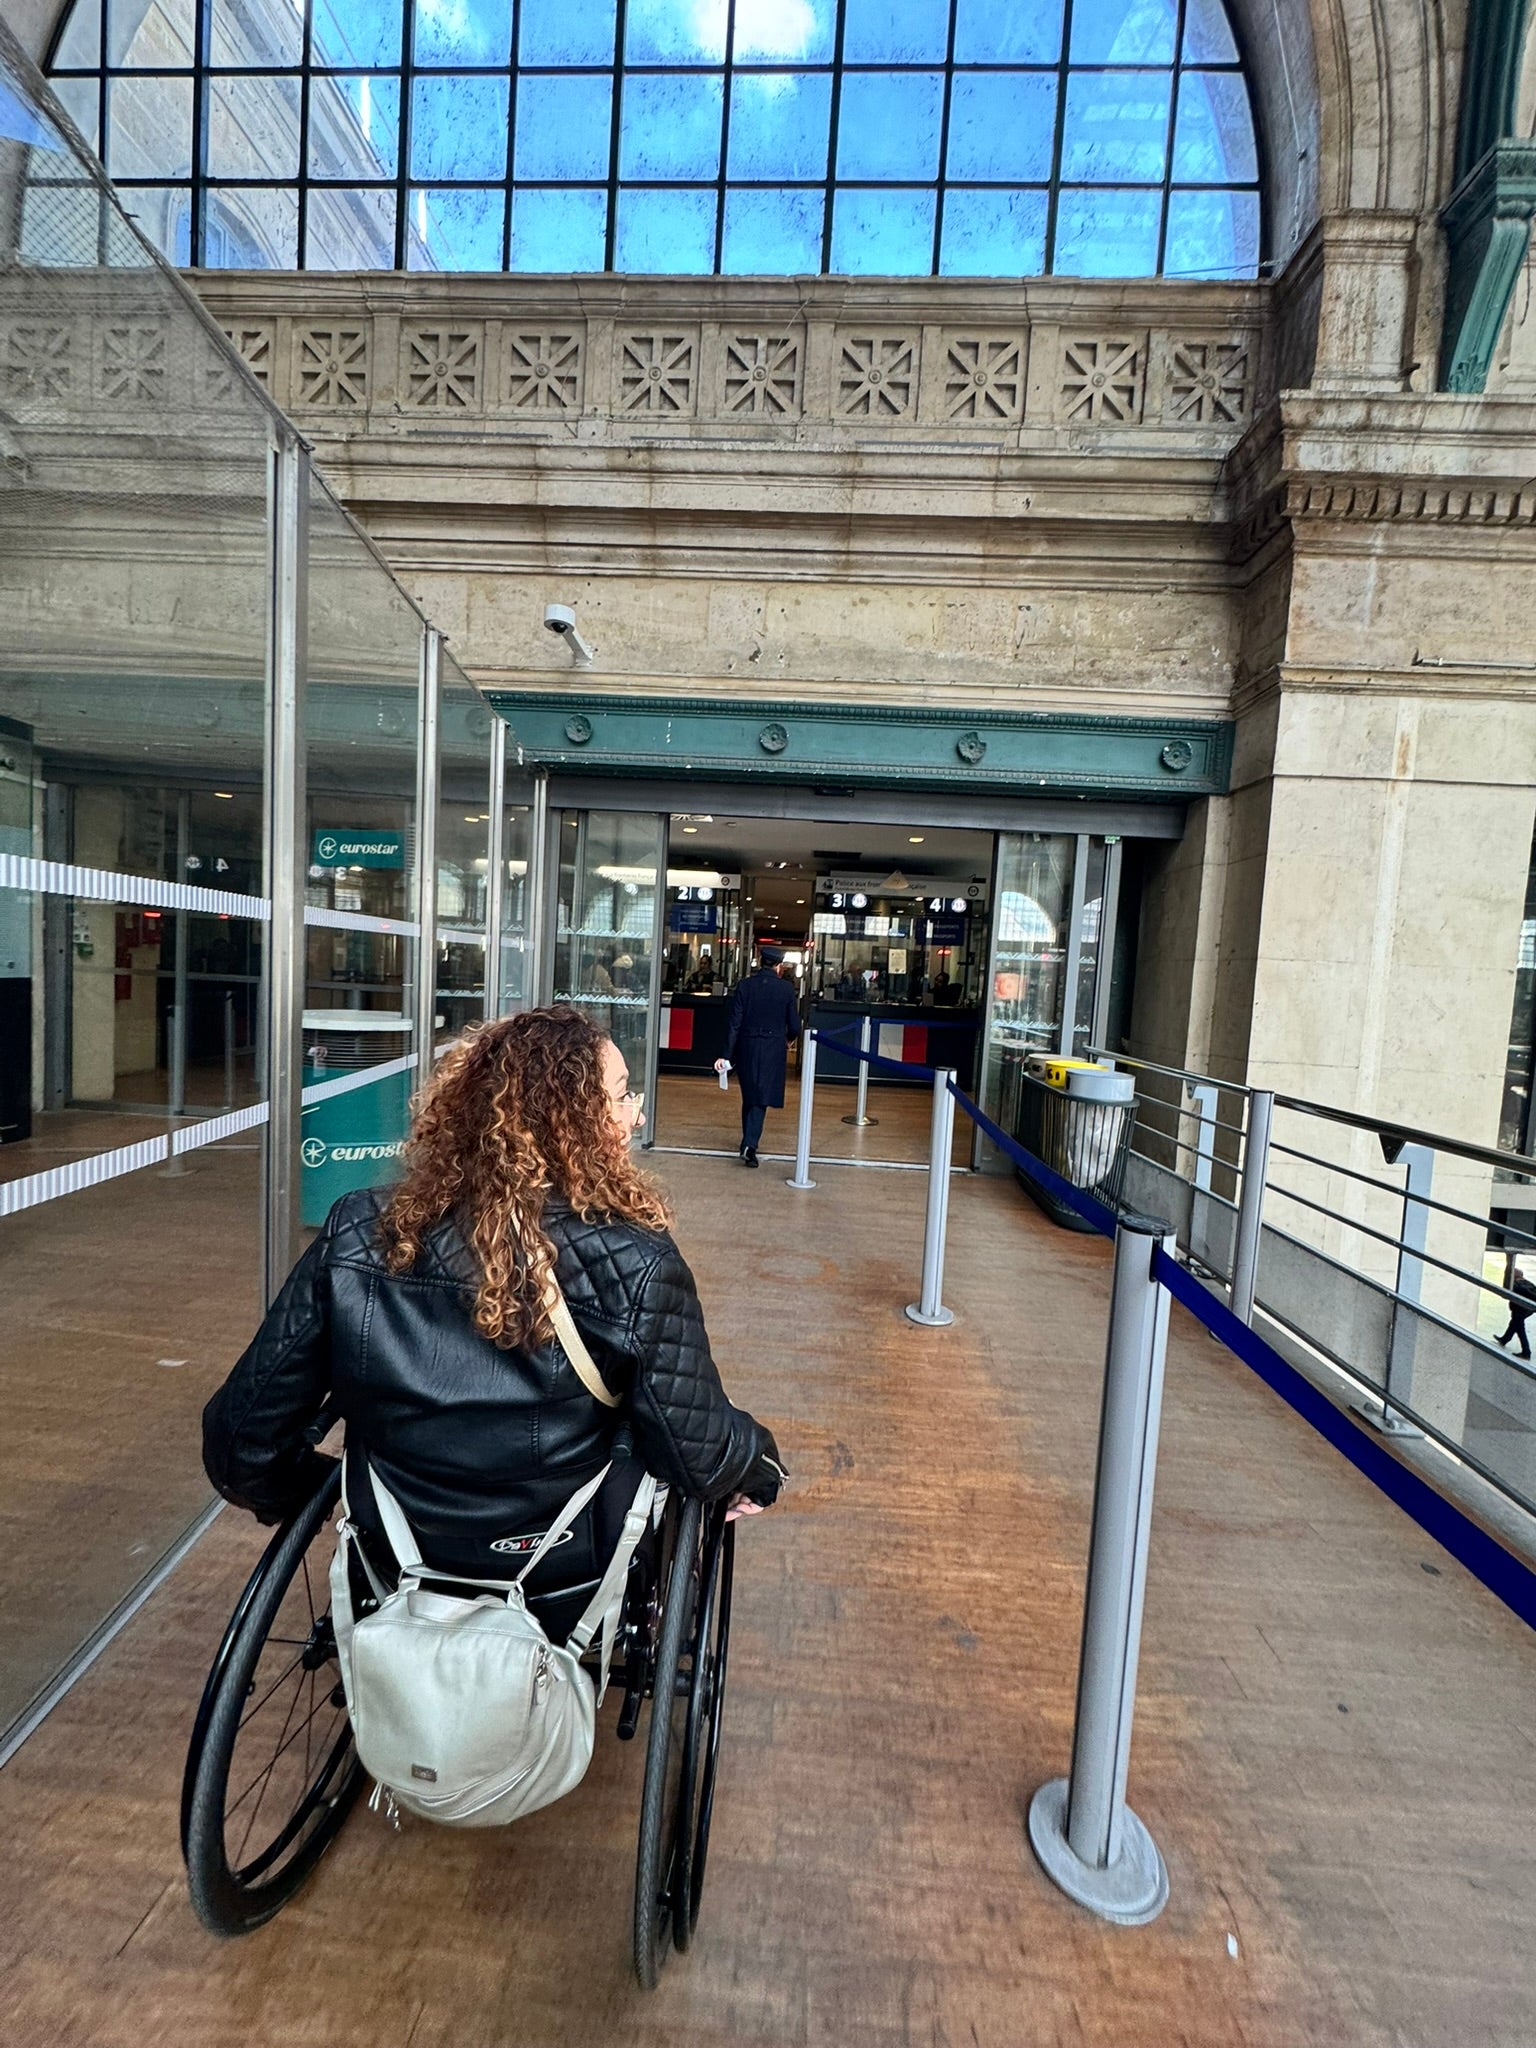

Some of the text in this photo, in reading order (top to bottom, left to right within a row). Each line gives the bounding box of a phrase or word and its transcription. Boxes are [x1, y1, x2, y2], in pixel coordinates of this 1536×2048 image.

[339, 843, 398, 854] eurostar
[677, 886, 689, 900] 2
[832, 893, 842, 908] 3
[929, 898, 941, 912] 4
[331, 1140, 404, 1160] eurost
